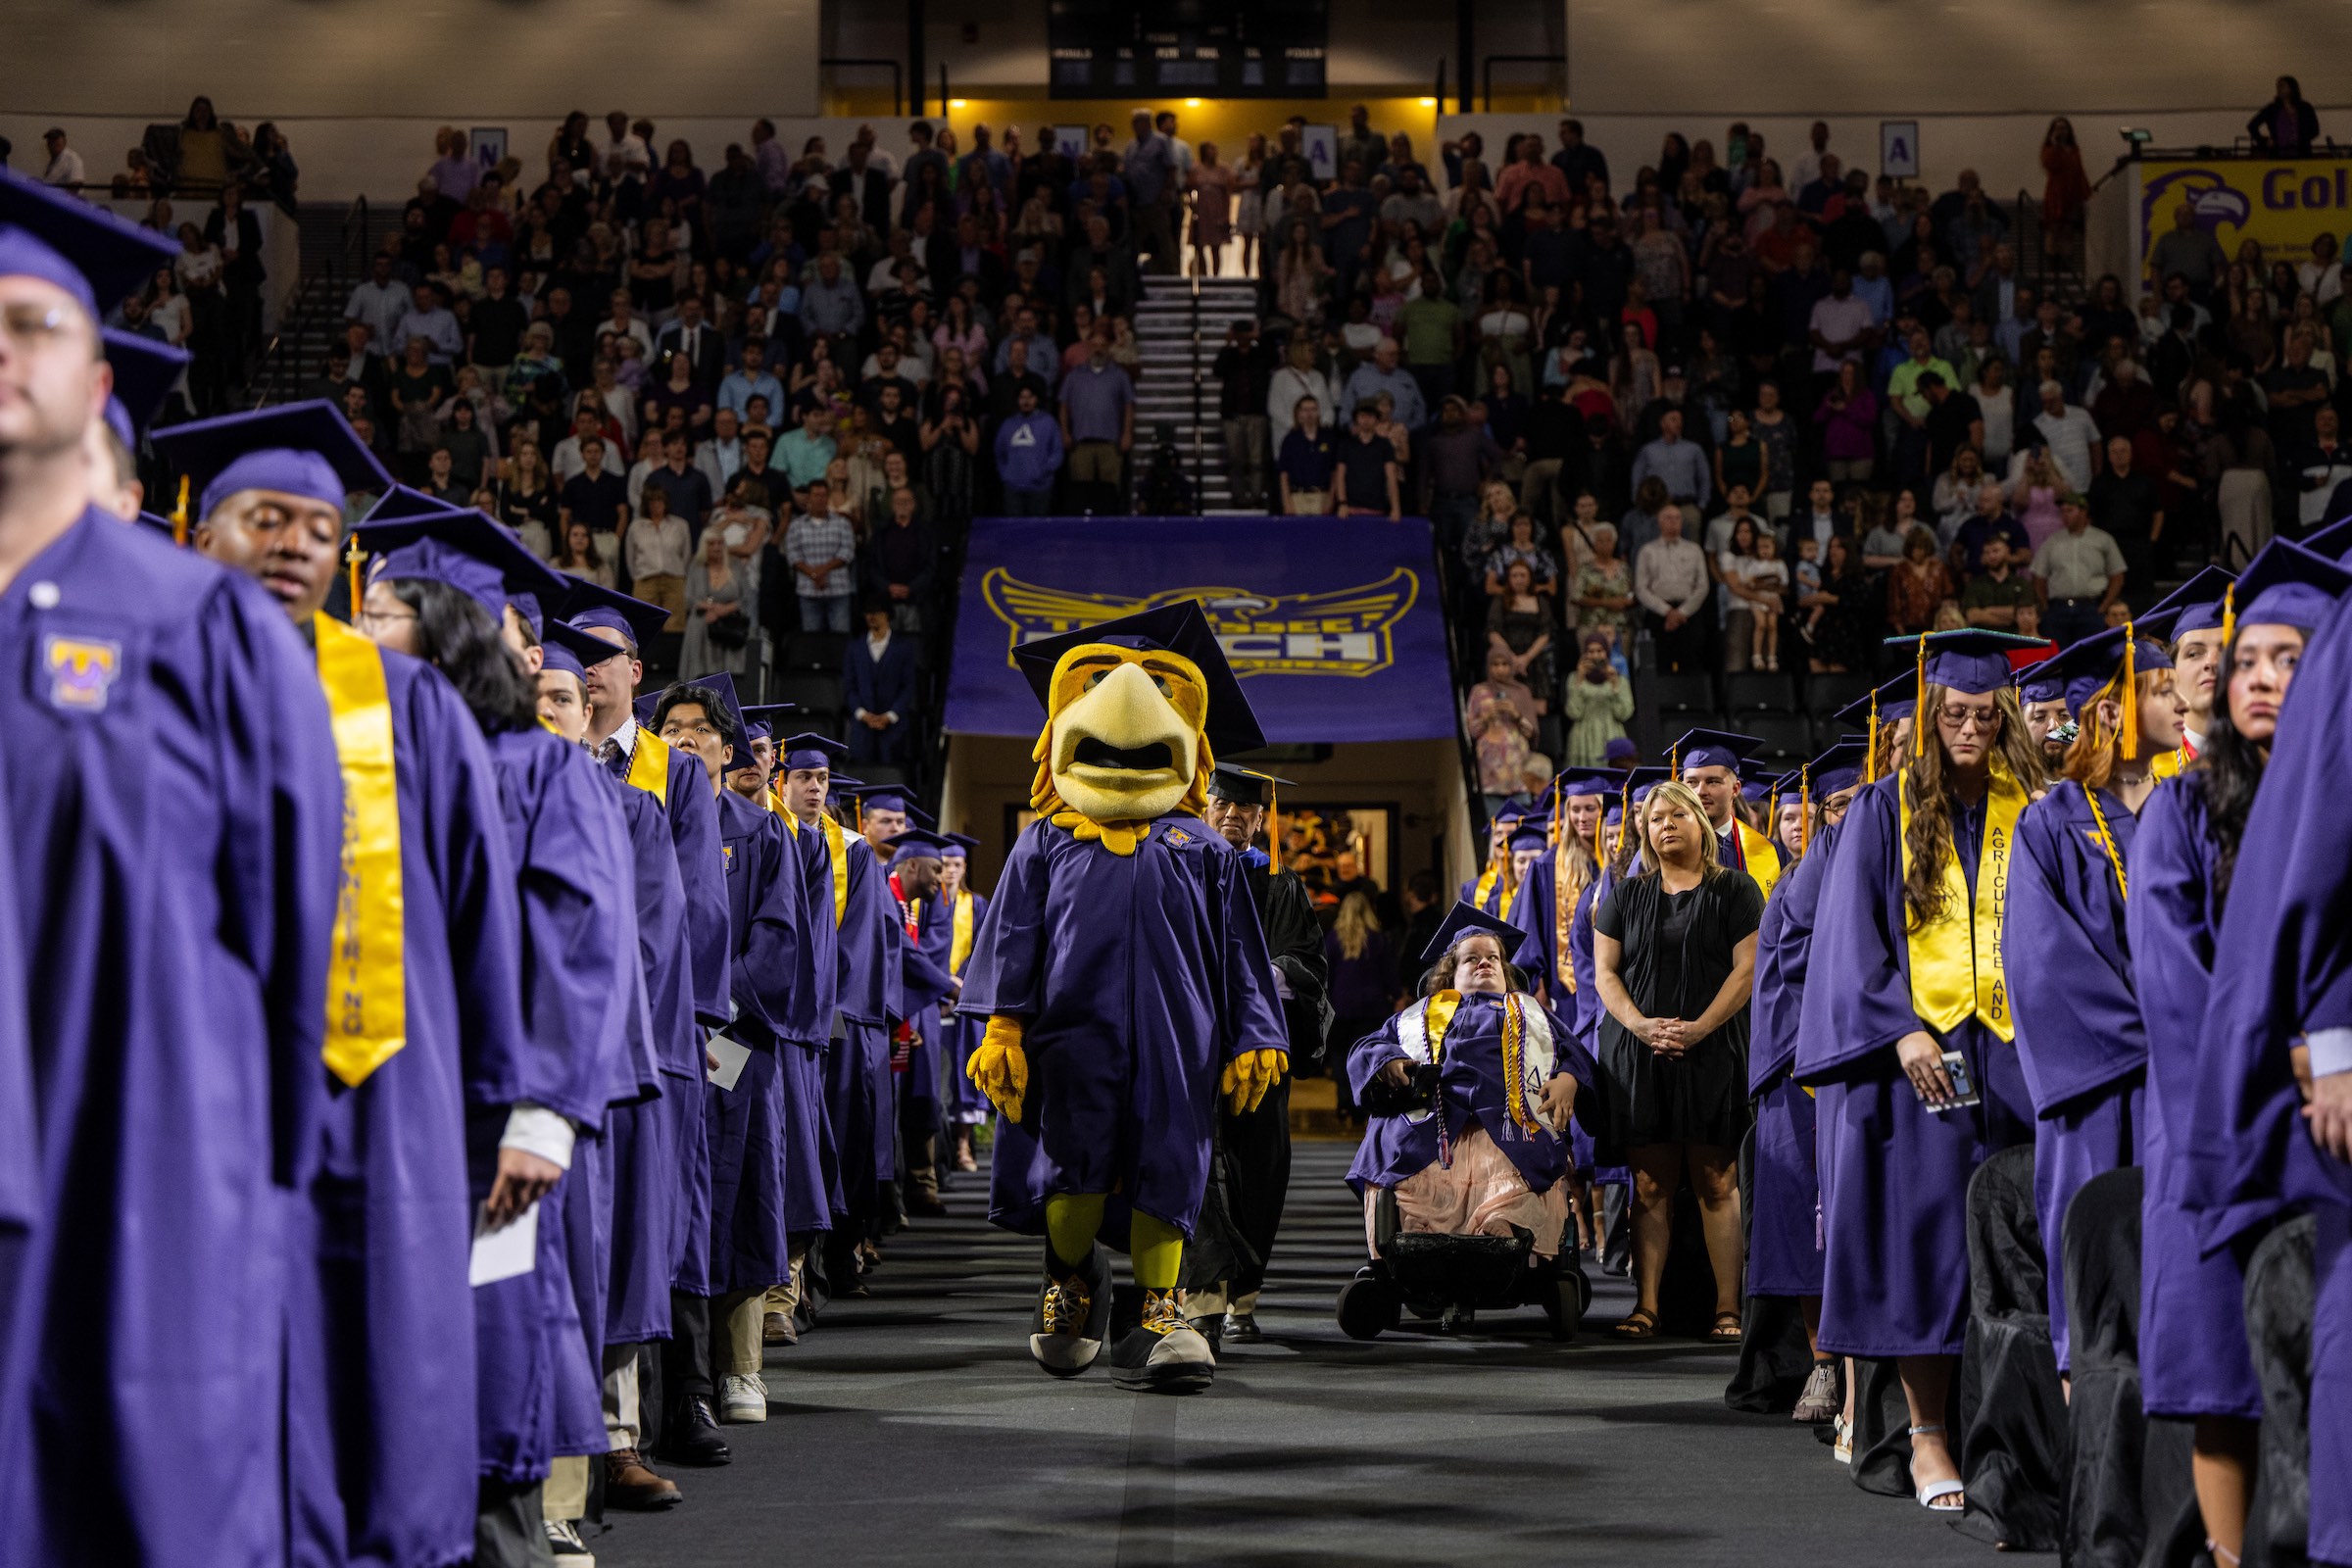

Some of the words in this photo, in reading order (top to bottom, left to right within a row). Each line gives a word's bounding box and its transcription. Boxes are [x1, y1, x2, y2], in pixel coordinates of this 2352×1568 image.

[479, 144, 498, 167] N
[1312, 139, 1328, 164] A
[1889, 136, 1909, 162] A
[2263, 168, 2346, 209] Gol
[340, 781, 364, 1036] NGINEERING
[1992, 827, 2005, 968] AGRICULTURE
[1991, 980, 2004, 1019] AND
